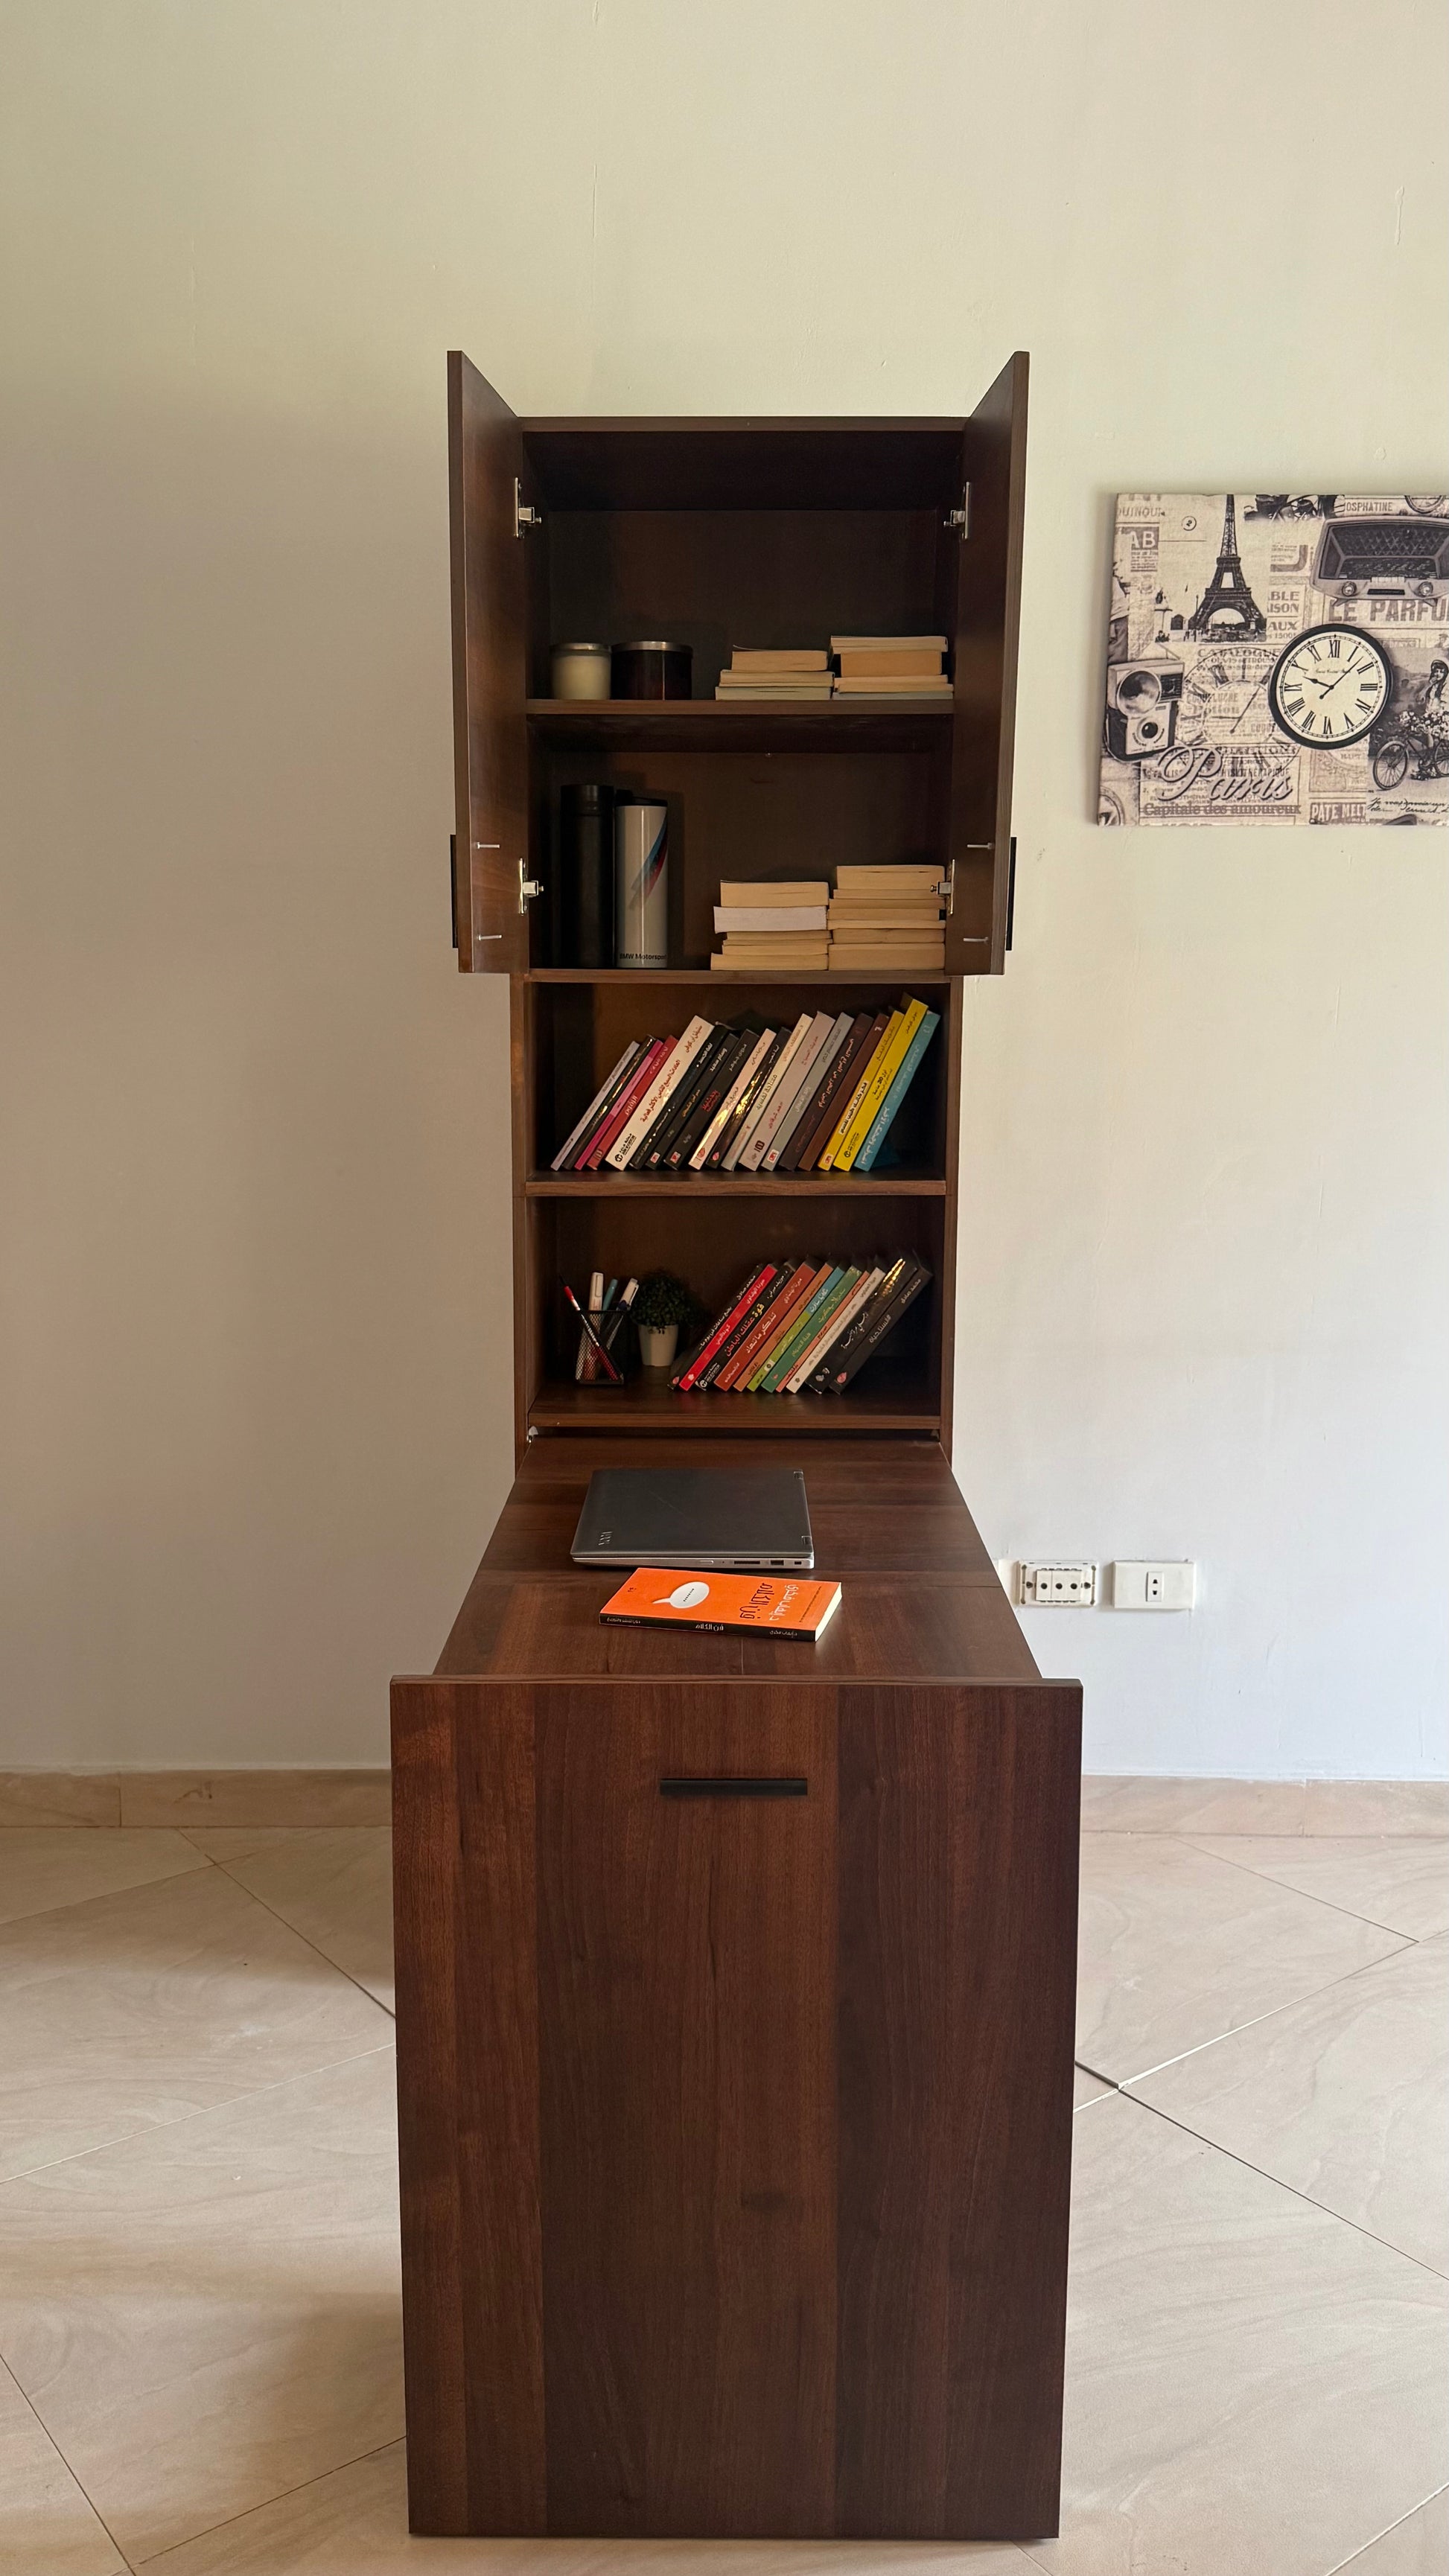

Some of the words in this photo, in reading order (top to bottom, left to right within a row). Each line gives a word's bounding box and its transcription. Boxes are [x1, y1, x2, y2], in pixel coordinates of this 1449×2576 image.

[1369, 599, 1449, 621] PARFU
[1157, 744, 1293, 801] Paris
[1142, 803, 1199, 817] Capitale
[1206, 803, 1227, 814] des
[1229, 803, 1301, 814] amoureux
[752, 1304, 764, 1317] قوة
[740, 1317, 756, 1334] عقلك
[724, 1333, 740, 1356] الباطن
[748, 1581, 774, 1605] الكلام
[739, 1604, 760, 1619] فن
